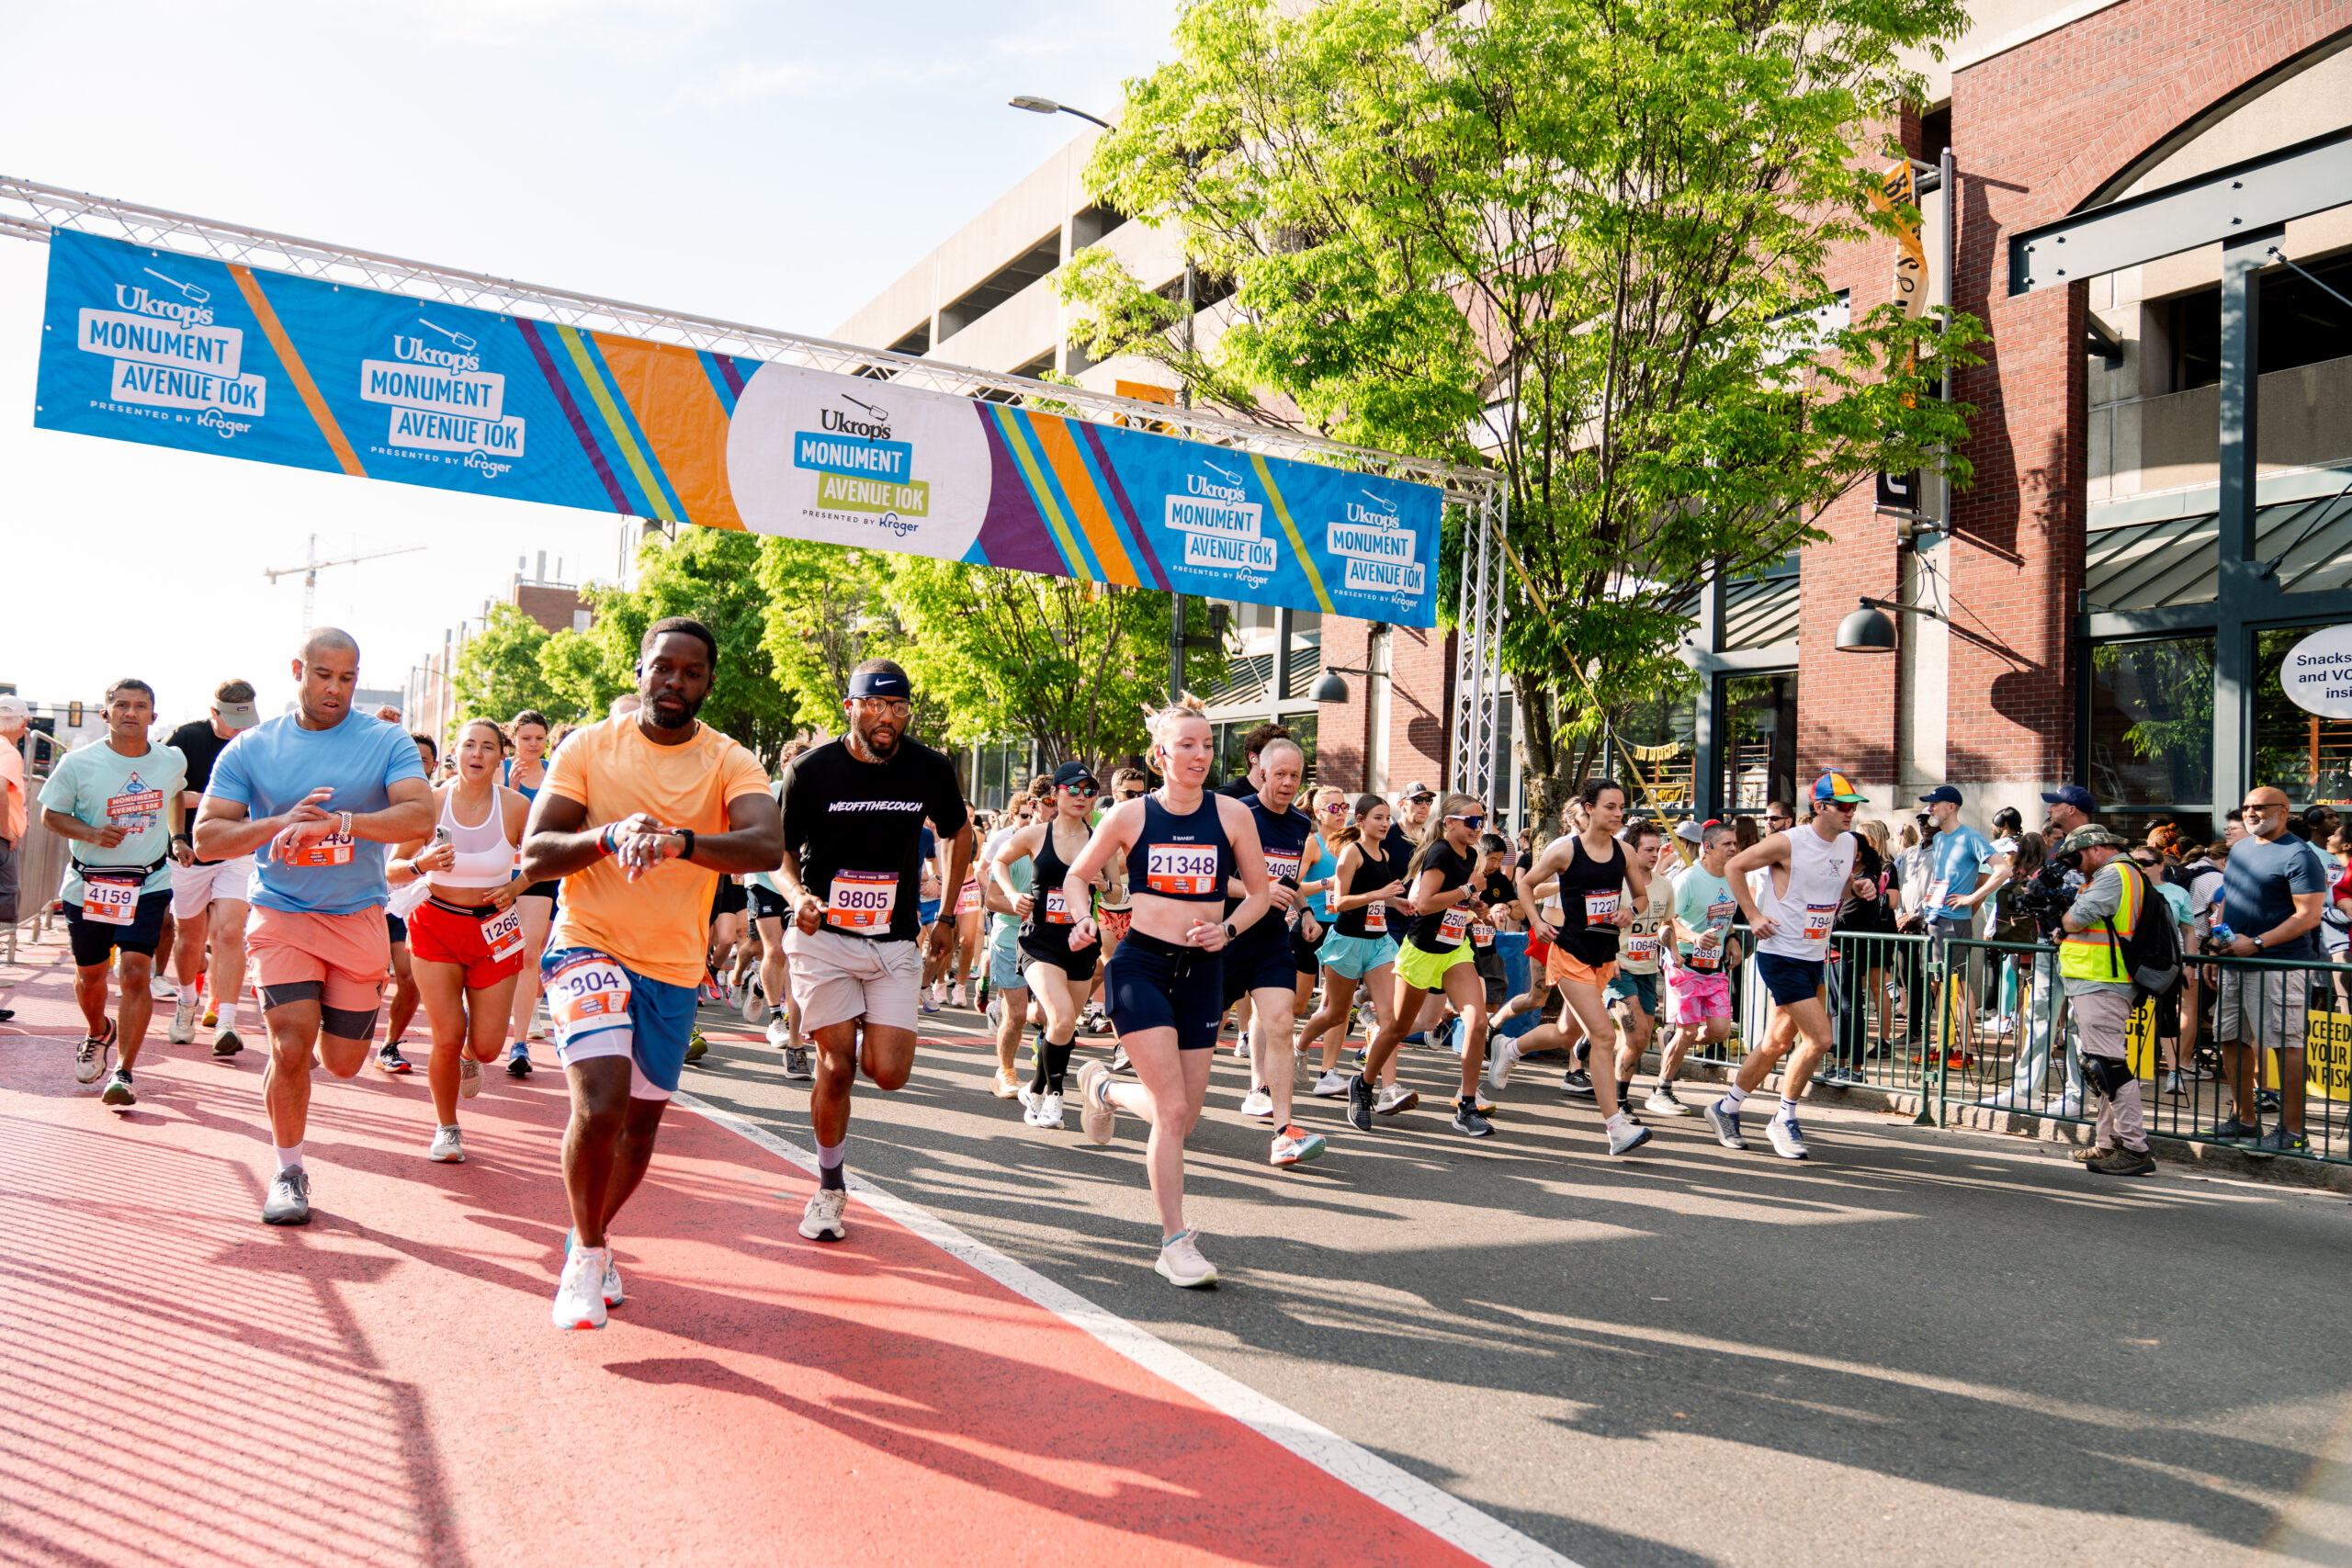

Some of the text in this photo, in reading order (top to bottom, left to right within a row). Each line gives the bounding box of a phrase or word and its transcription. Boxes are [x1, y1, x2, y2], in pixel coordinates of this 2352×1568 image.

[115, 284, 213, 329] Ukrop's
[90, 320, 229, 364] MONUMENT
[393, 335, 480, 376] Ukrop's
[121, 365, 213, 401] AVENUE
[370, 369, 492, 408] MONUMENT
[90, 400, 252, 438] PRESENTED BY Kroger
[397, 412, 478, 444] AVENUE
[820, 409, 891, 443] Ukrop's
[371, 446, 438, 462] PRESENTED
[464, 451, 512, 479] Kroger
[801, 439, 903, 473] MONUMENT
[823, 477, 890, 507] AVENUE
[1187, 474, 1246, 505] Ukrop's
[802, 509, 859, 523] PRESENTED
[879, 513, 919, 537] Kroger
[1172, 503, 1253, 532] MONUMENT
[1347, 502, 1400, 532] Ukrop's
[1191, 539, 1245, 560] AVENUE
[1333, 532, 1408, 556] MONUMENT
[1173, 565, 1219, 577] PRESENTED
[1236, 566, 1269, 589] Kroger
[1350, 562, 1399, 584] AVENUE
[1334, 589, 1377, 601] PRESENTED
[1391, 590, 1418, 612] Kroger
[2297, 652, 2352, 666] Snacks
[2299, 671, 2326, 683] and
[111, 805, 142, 815] AVENUE
[112, 792, 160, 806] MONUMENT
[828, 801, 923, 812] WEOFFTHECOUCH
[1150, 855, 1215, 874] 21348
[89, 888, 131, 904] 4159
[838, 890, 888, 908] 9805
[1591, 899, 1616, 914] 7227
[1630, 940, 1657, 951] 10646
[1693, 947, 1721, 958] 26931
